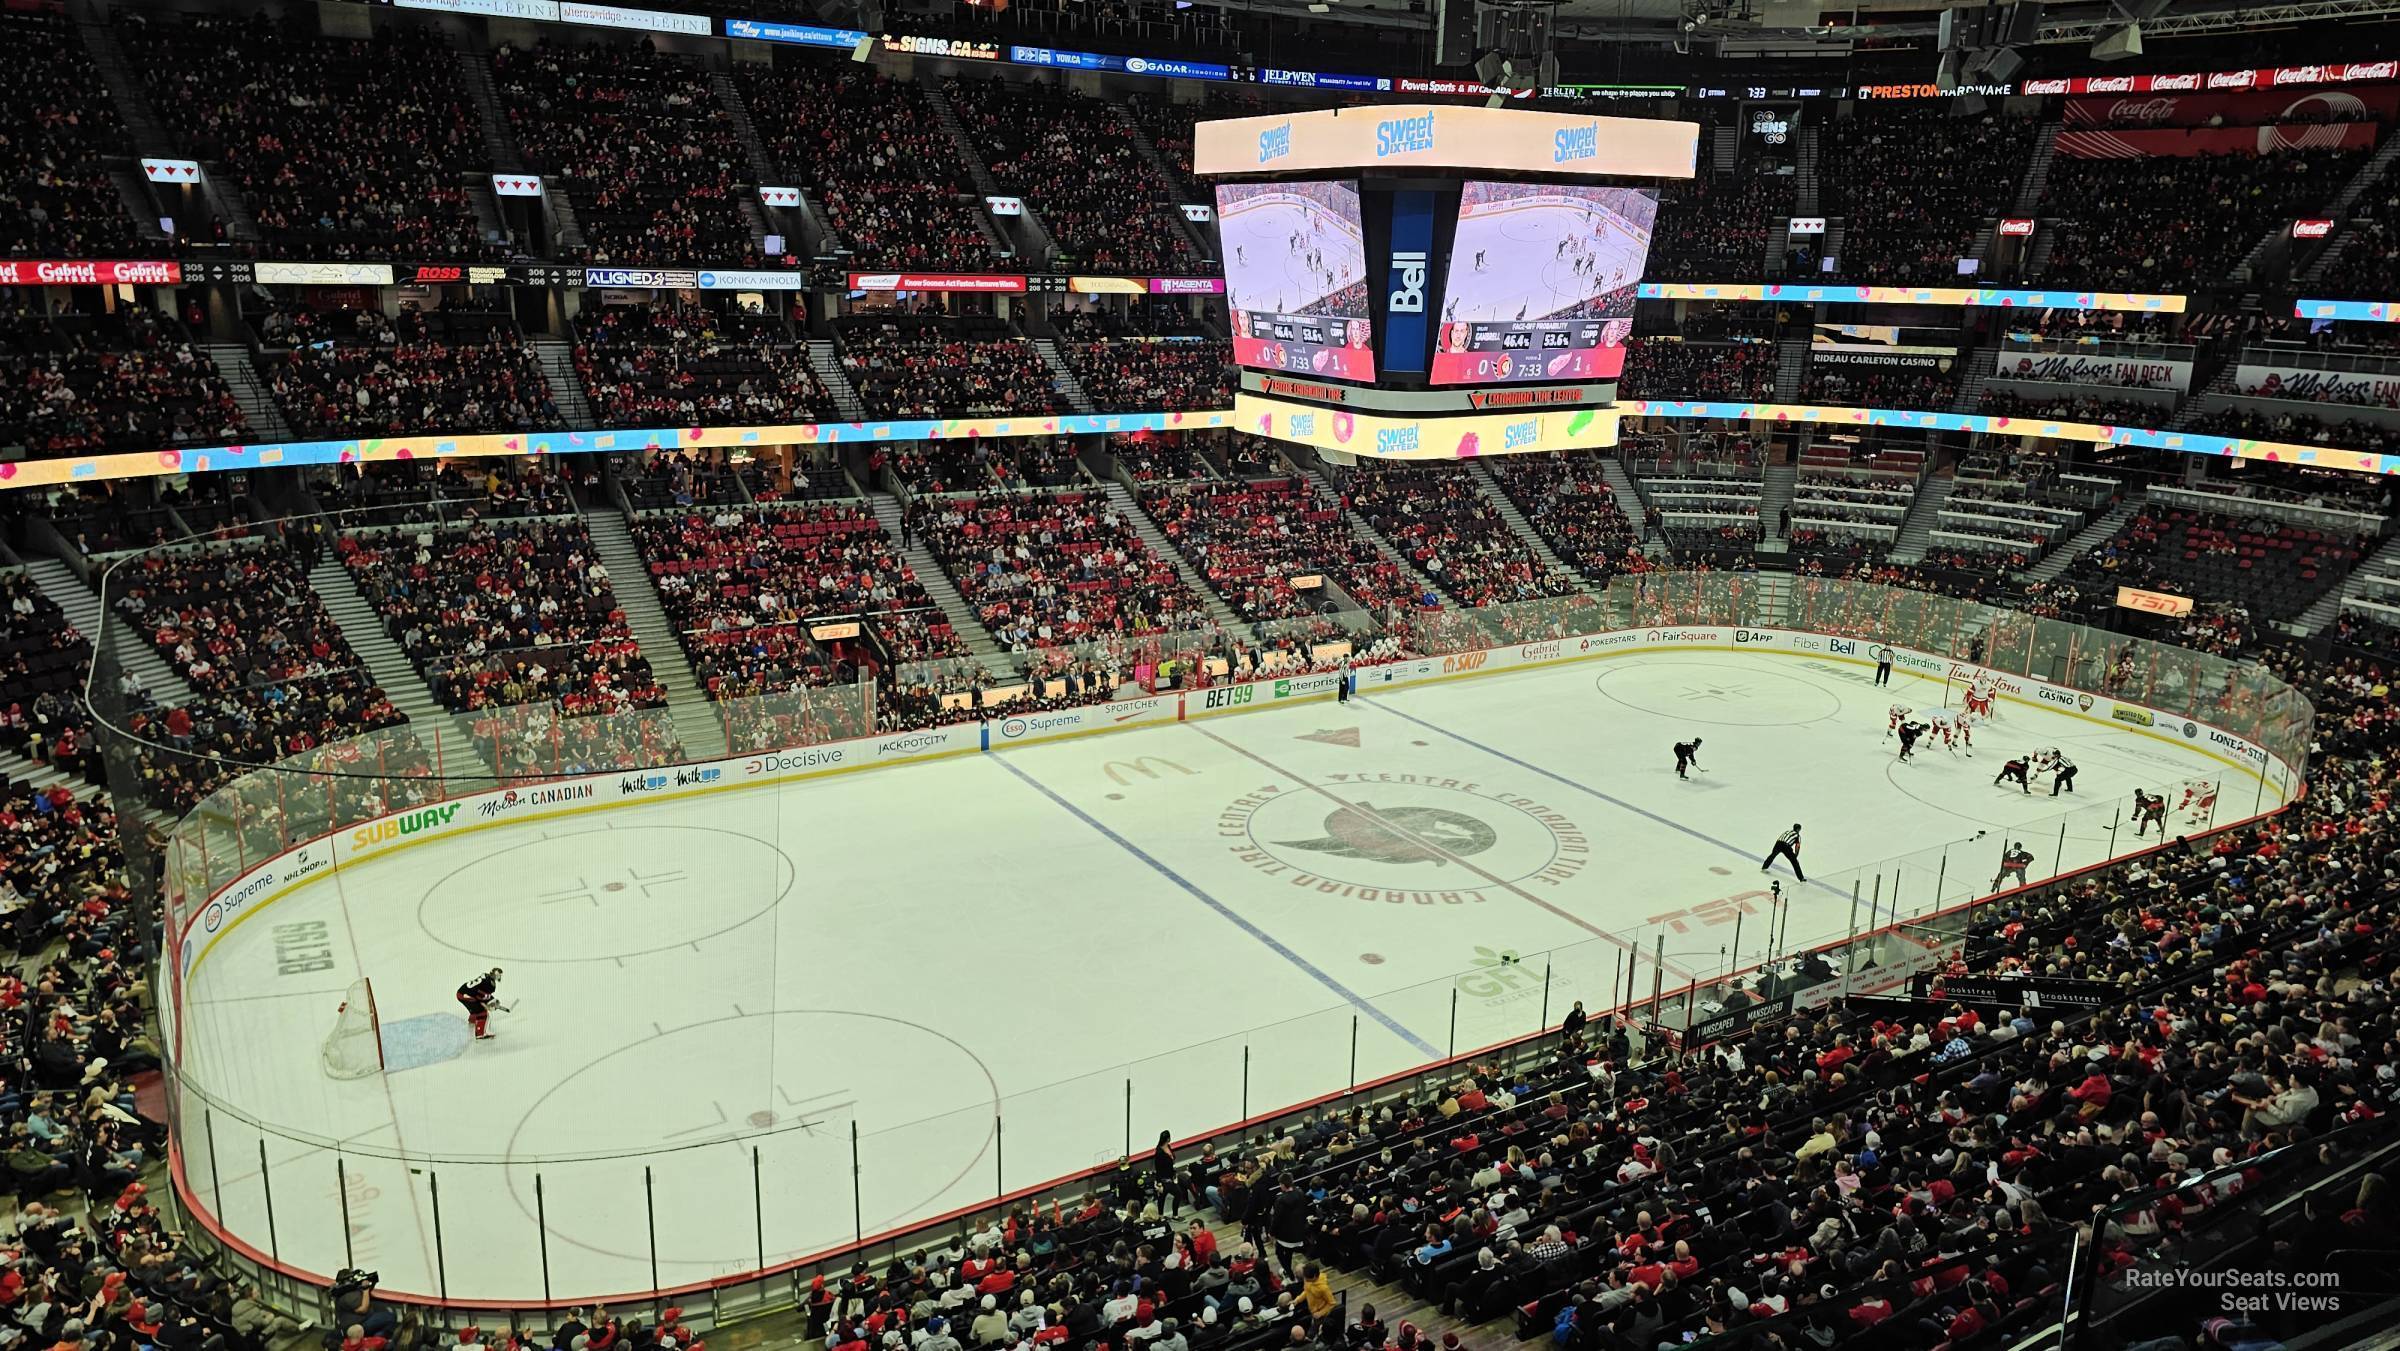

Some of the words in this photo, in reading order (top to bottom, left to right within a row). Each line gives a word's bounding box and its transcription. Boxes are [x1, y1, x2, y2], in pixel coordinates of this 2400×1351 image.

[900, 36, 971, 57] SIGNS.CA
[1056, 53, 1081, 65] YOW.CA
[1147, 63, 1188, 75] GADAR
[1429, 81, 1455, 93] Sports
[1458, 84, 1465, 92] &
[1468, 84, 1479, 93] RV
[2027, 80, 2068, 94] Coca-Cola
[2089, 78, 2131, 92] Coca-Cola
[2153, 75, 2197, 90] Coca-Cola
[1700, 88, 1706, 98] 0
[1748, 88, 1766, 98] 7:33
[1872, 84, 1939, 99] PRESTON
[2108, 98, 2179, 120] Coca-Cola
[1753, 111, 1775, 123] GO
[1753, 121, 1788, 134] SENS
[1765, 132, 1787, 144] GO
[38, 263, 95, 282] Gabriel
[114, 263, 168, 282] Gabriel
[184, 263, 203, 272] 305
[230, 264, 249, 272] 306
[416, 267, 462, 279] ROSS
[528, 269, 545, 277] 306
[565, 269, 582, 277] 307
[185, 273, 204, 282] 205
[231, 274, 250, 282] 206
[528, 277, 545, 286] 206
[567, 278, 583, 286] 207
[588, 271, 651, 286] ALIGNED
[719, 275, 756, 286] KONICA
[759, 276, 800, 286] MINOLTA
[1172, 280, 1213, 289] MAGENTA
[1390, 252, 1426, 312] Bell
[1503, 335, 1530, 348] 46.4%
[1544, 333, 1570, 347] 53.6%
[1263, 347, 1270, 361] 0
[1814, 354, 1848, 364] RIDEAU
[1850, 355, 1899, 366] CARLETON
[1291, 356, 1310, 370] 7:33
[1333, 355, 1340, 370] 1
[1478, 359, 1488, 376] 0
[1518, 363, 1542, 377] 7:33
[1574, 357, 1582, 372] 1
[2035, 356, 2112, 379] Molson
[2115, 363, 2138, 380] FAN
[2141, 365, 2174, 383] DECK
[2131, 592, 2178, 612] TSN
[819, 626, 851, 639] TSN
[1662, 631, 1718, 643] FairSquare
[1590, 634, 1637, 648] POKERSTARS
[1793, 636, 1820, 650] Fibe
[1830, 638, 1856, 656] Bell
[1522, 641, 1561, 661] Gabriel
[1532, 652, 1562, 661] PIZZA
[1456, 652, 1488, 673] SKIP
[1893, 651, 1942, 673] esjardins
[1948, 662, 1970, 681] Tim
[1280, 676, 1339, 693] enterprise
[1206, 684, 1254, 709] BET99
[1105, 698, 1159, 714] SPORTCHEK
[1030, 715, 1082, 731] Supreme
[878, 734, 948, 755] JACKPOTCITY
[2209, 731, 2236, 751] LONE
[766, 749, 843, 773] Decisive
[1357, 772, 1481, 793] CENTRE
[478, 792, 526, 818] Molson
[531, 784, 593, 806] CANADIAN
[1217, 792, 1271, 838] CENTRE
[351, 801, 462, 852] SUBWAY
[1498, 792, 1590, 854] CANADIAN
[1229, 845, 1288, 876] TIRE
[1533, 857, 1588, 887] TIRE
[224, 873, 274, 913] Supreme
[1290, 874, 1488, 906] CANADIAN
[1647, 889, 1785, 935] TSN
[273, 920, 335, 977] BET99
[2040, 992, 2102, 1004] brookstreet
[1746, 1001, 1784, 1023] MANSCAPED
